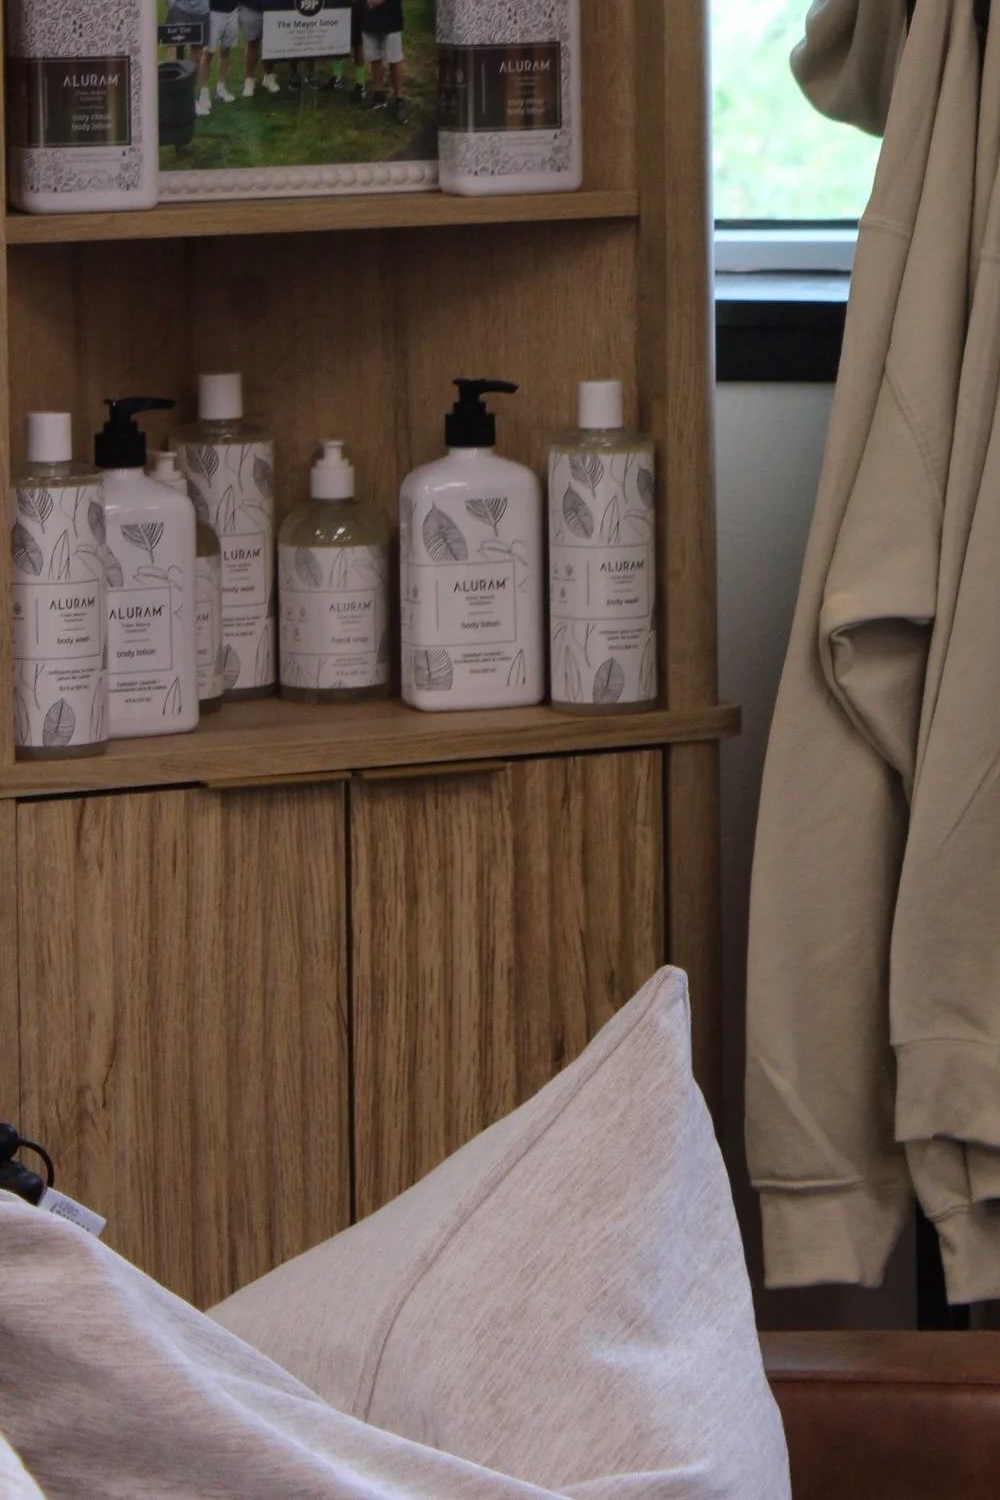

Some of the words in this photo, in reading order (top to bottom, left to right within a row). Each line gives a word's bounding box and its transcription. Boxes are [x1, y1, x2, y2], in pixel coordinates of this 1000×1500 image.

[293, 20, 317, 29] Mayor
[499, 60, 550, 73] ALURAM
[63, 74, 119, 87] ALURAM
[223, 548, 260, 560] LURAM
[600, 560, 644, 572] ALURAM
[454, 579, 506, 592] ALURAM
[49, 597, 95, 610] ALURAM
[329, 601, 371, 612] ALURAM
[109, 606, 163, 620] ALURAM
[461, 622, 479, 630] body
[480, 620, 500, 628] lotion
[56, 637, 73, 646] body
[116, 649, 134, 658] body
[136, 647, 156, 657] lotion
